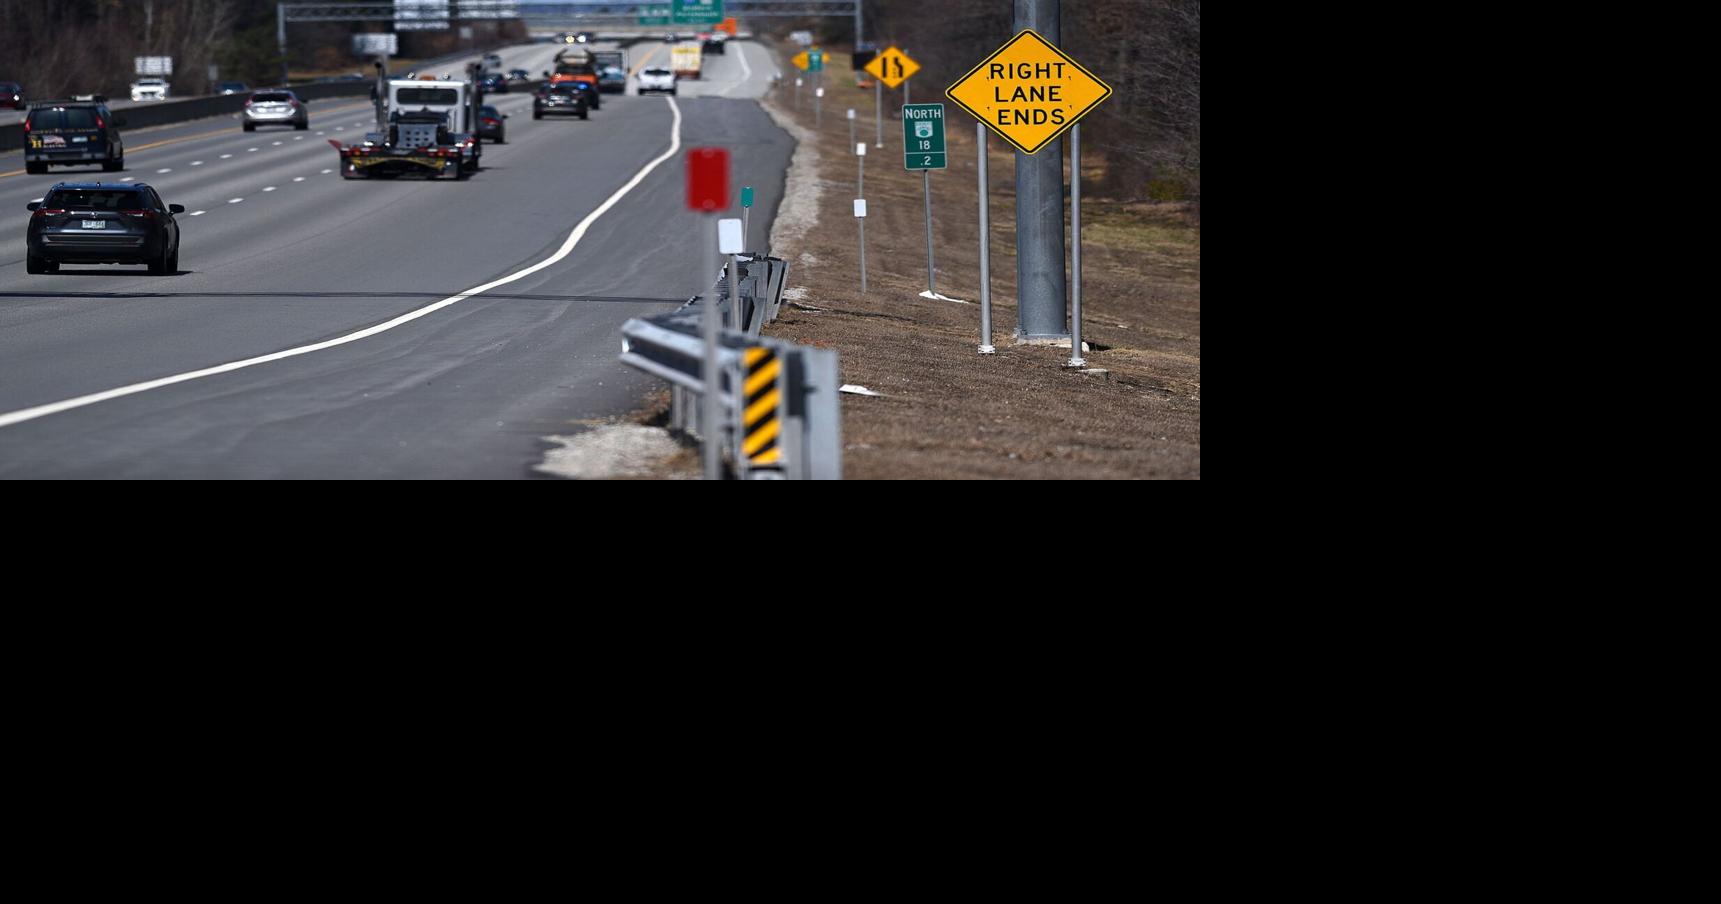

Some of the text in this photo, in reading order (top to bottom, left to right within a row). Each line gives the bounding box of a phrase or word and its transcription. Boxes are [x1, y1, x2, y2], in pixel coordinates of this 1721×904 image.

[990, 62, 1066, 79] RIGHT
[995, 86, 1062, 102] LANE
[905, 108, 942, 119] NORTH
[998, 108, 1065, 125] ENDS
[919, 140, 931, 150] 18
[920, 155, 932, 166] .2
